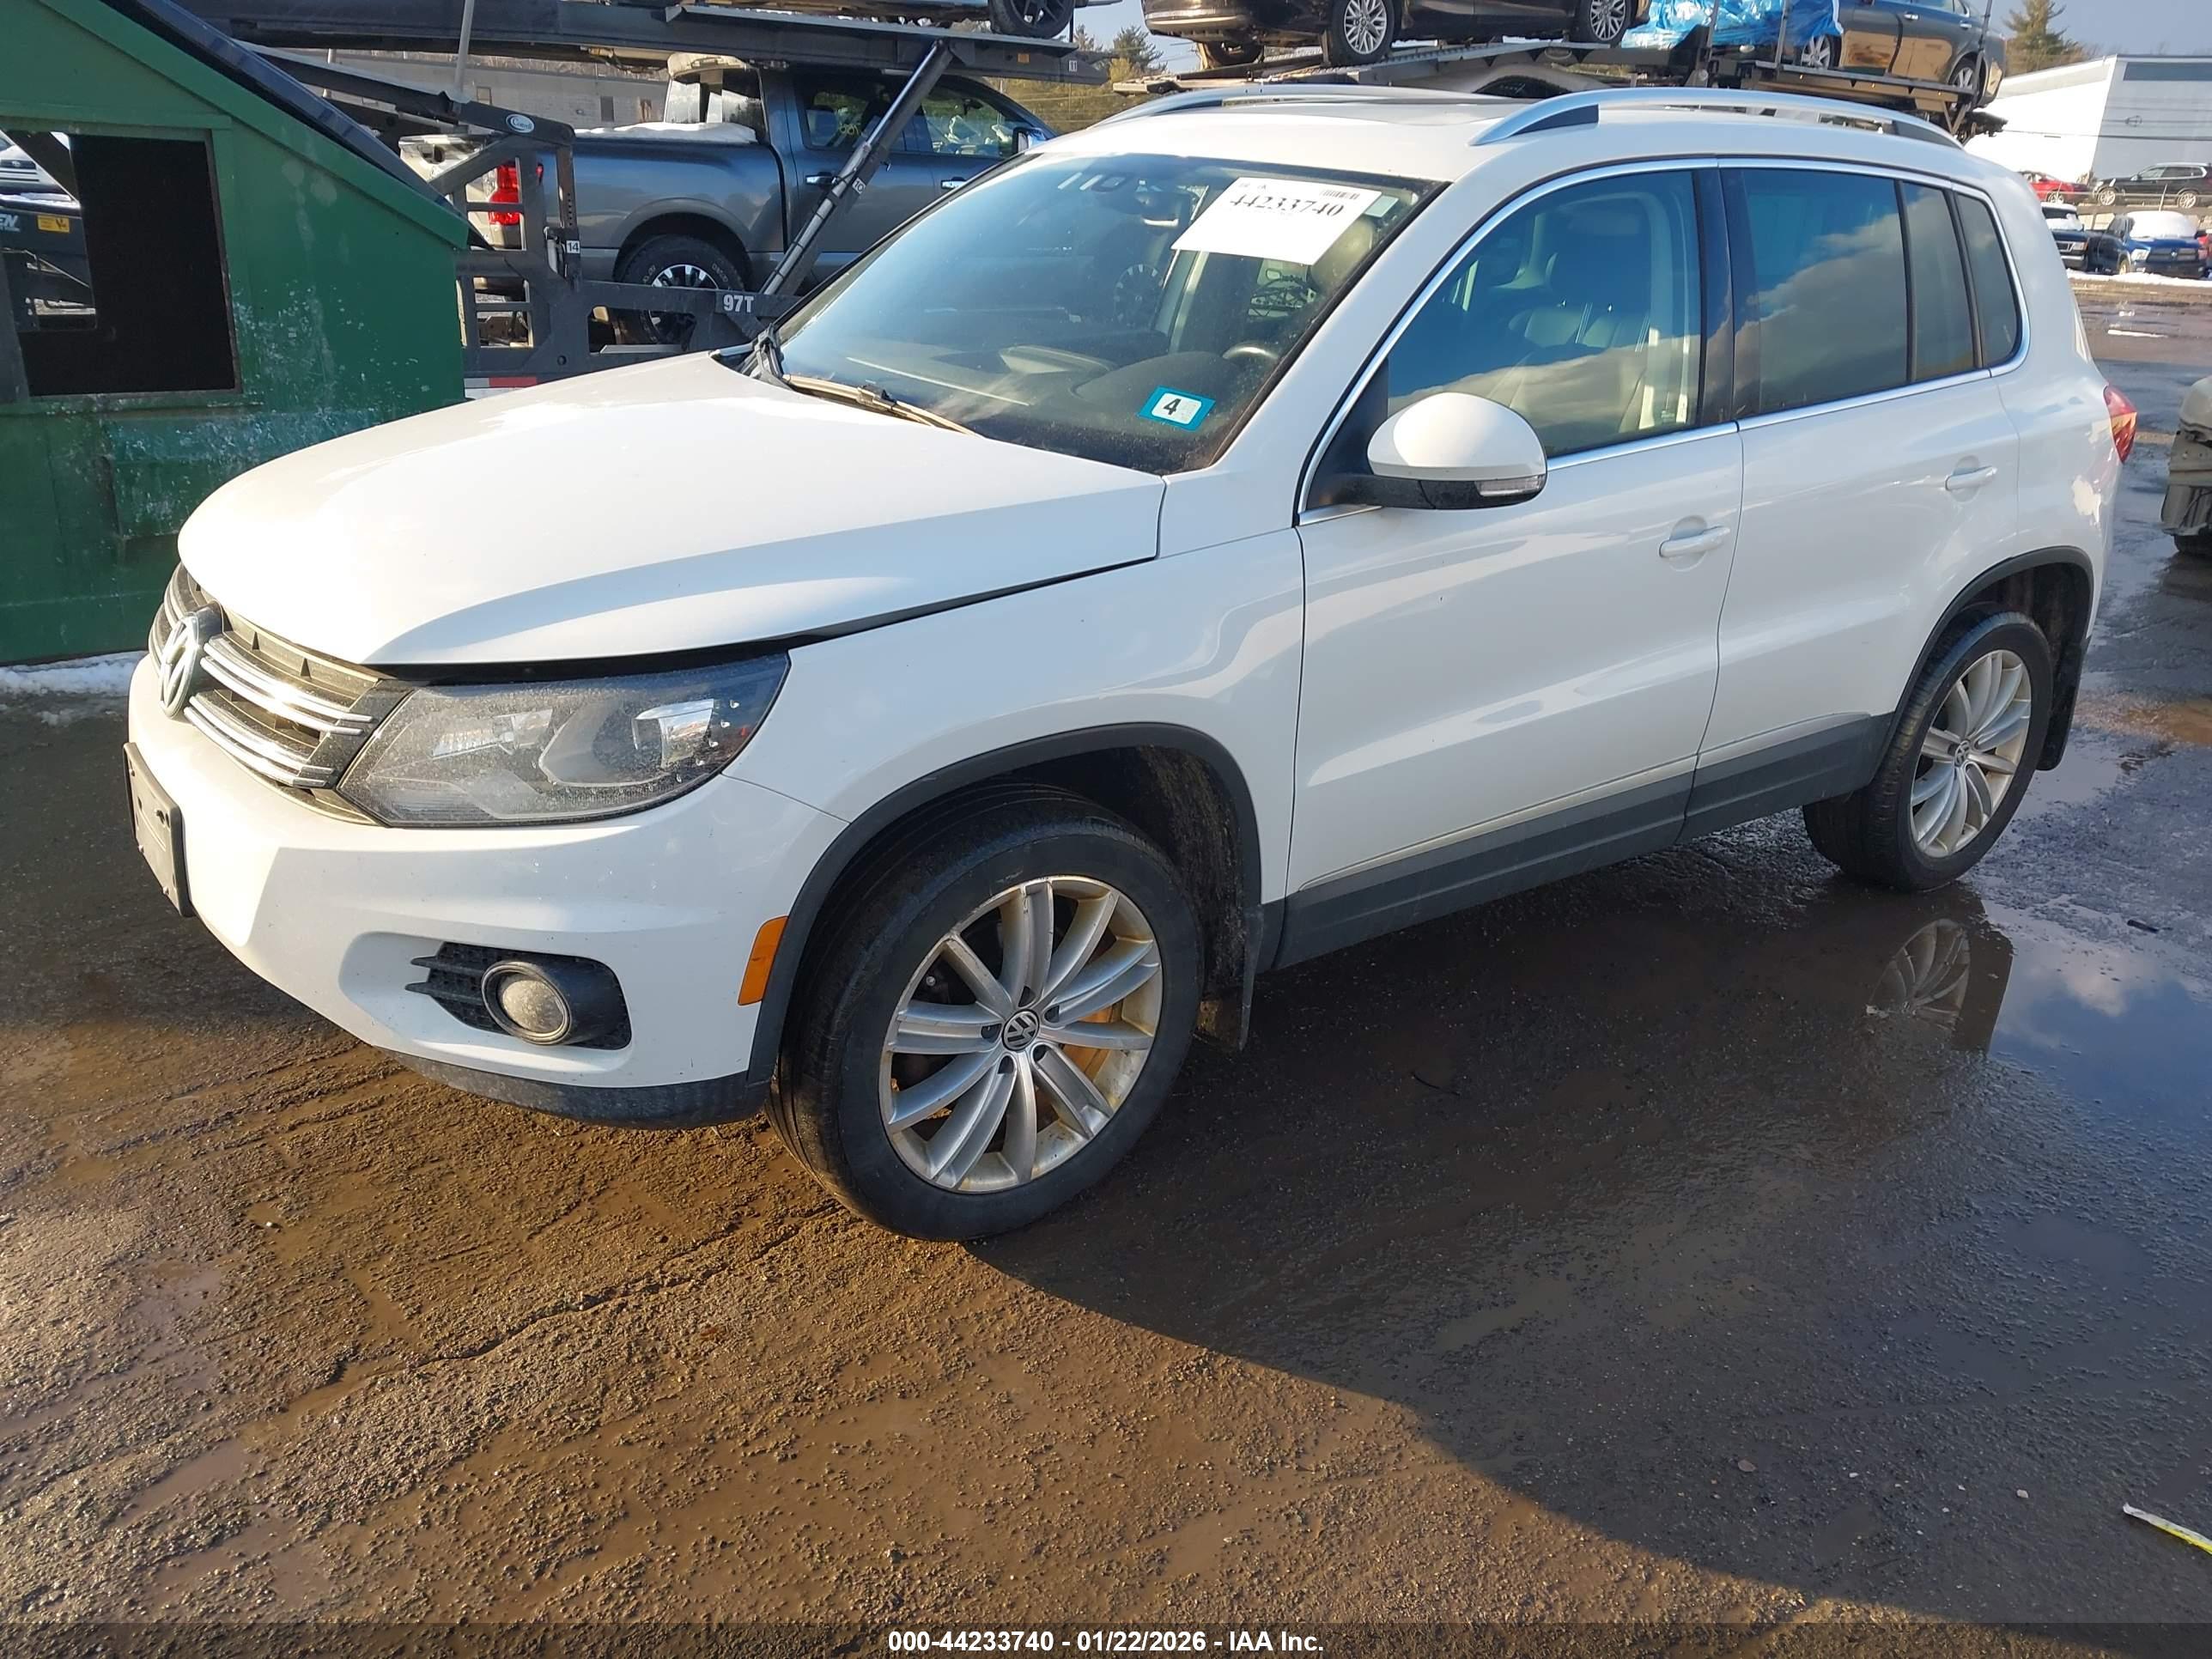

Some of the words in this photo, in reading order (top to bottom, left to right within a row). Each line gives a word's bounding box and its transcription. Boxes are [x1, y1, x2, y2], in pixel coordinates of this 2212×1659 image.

[1230, 193, 1345, 217] 44233740
[568, 242, 579, 252] 14
[723, 294, 754, 313] 97T
[1163, 398, 1182, 416] 4
